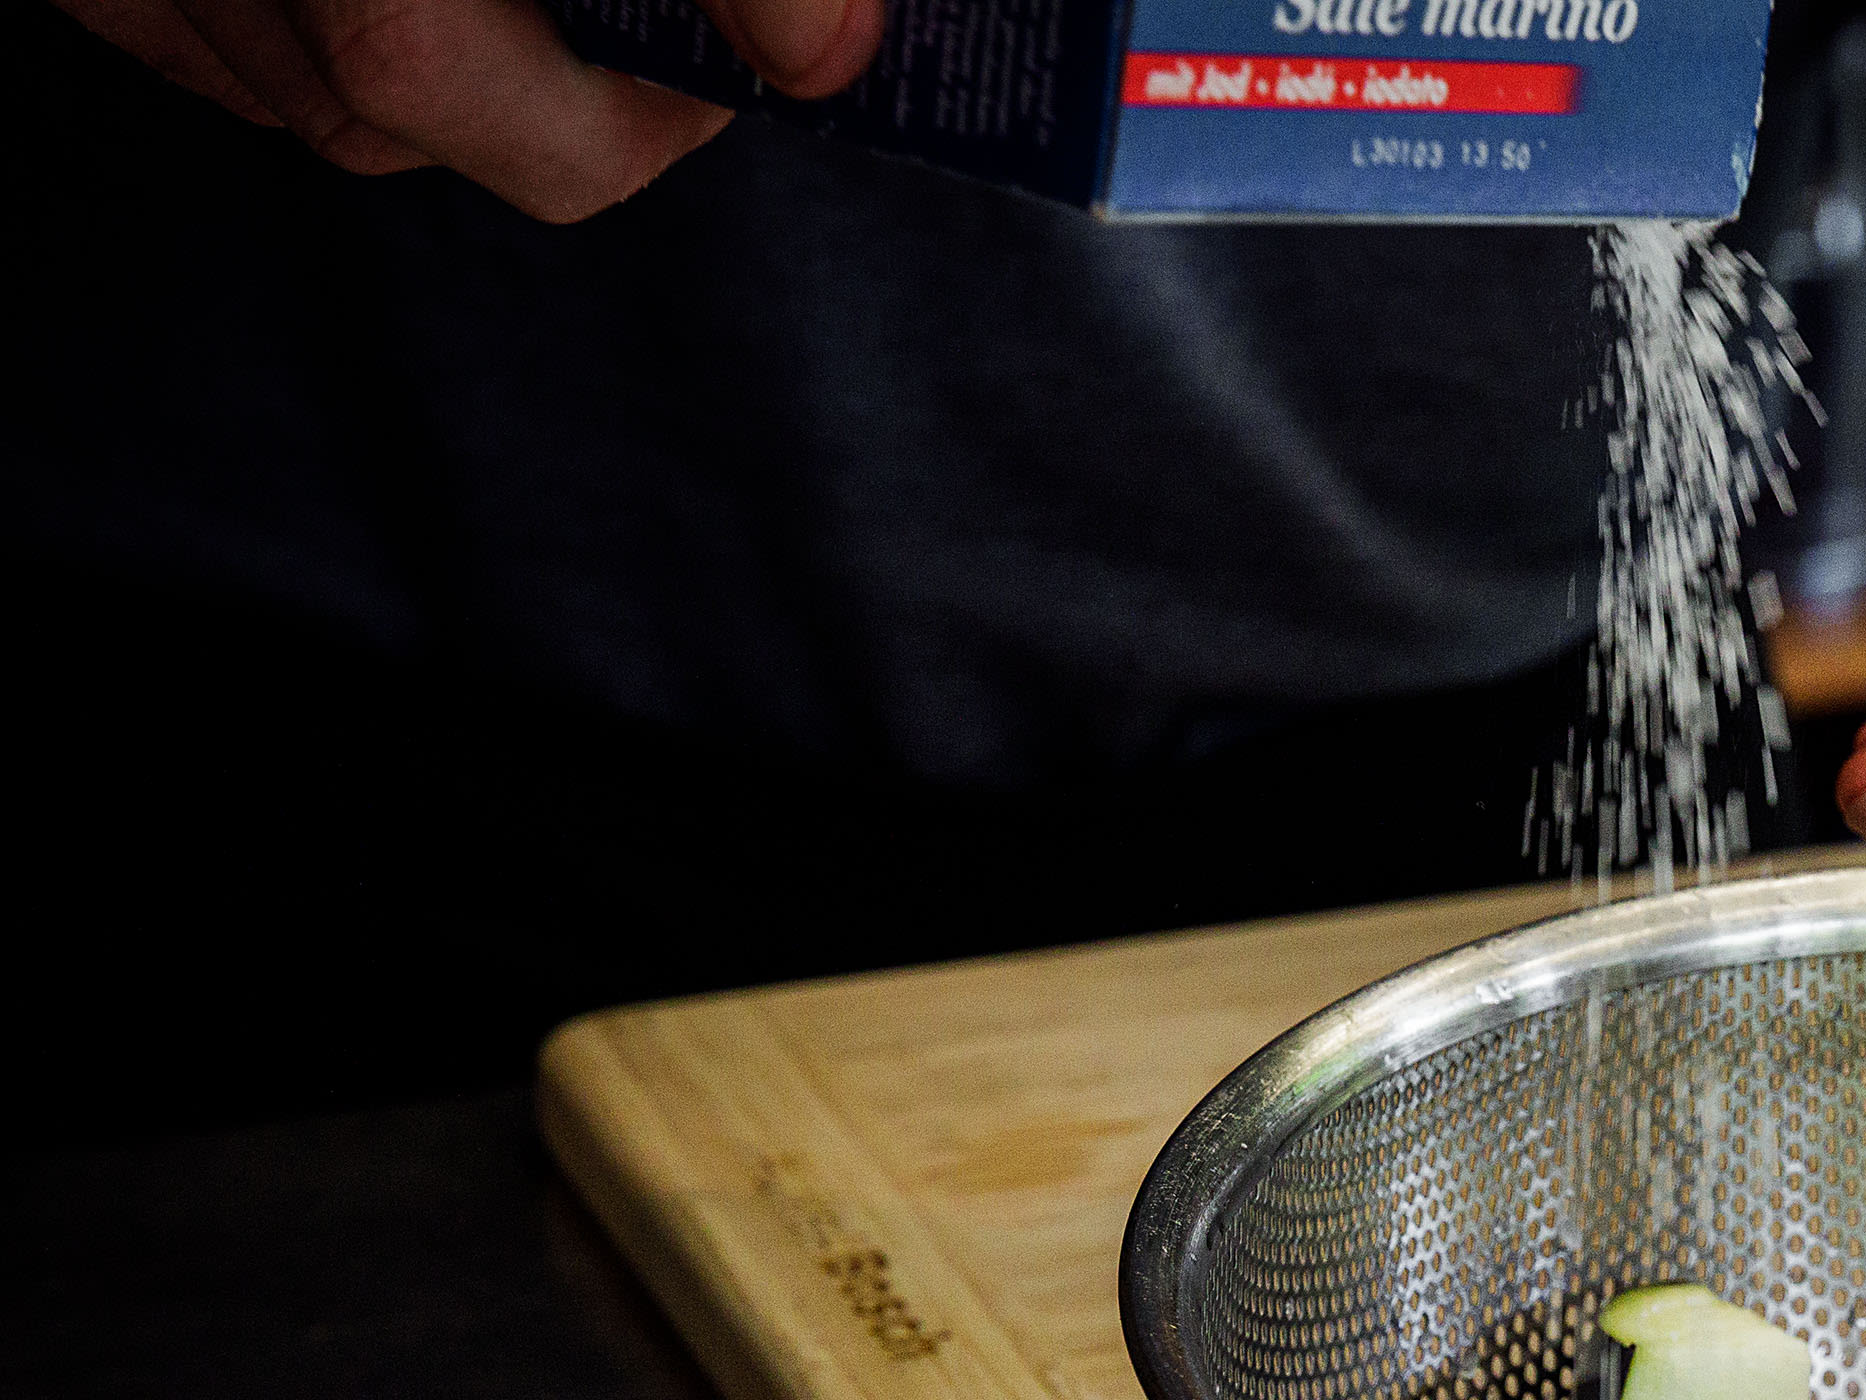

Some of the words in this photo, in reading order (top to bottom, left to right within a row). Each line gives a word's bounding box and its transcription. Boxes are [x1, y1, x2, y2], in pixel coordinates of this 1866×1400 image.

[1421, 0, 1639, 43] marino
[1145, 58, 1195, 100] mit
[1197, 60, 1253, 102] Jod
[1362, 64, 1449, 107] iodato
[1461, 139, 1488, 169] 13
